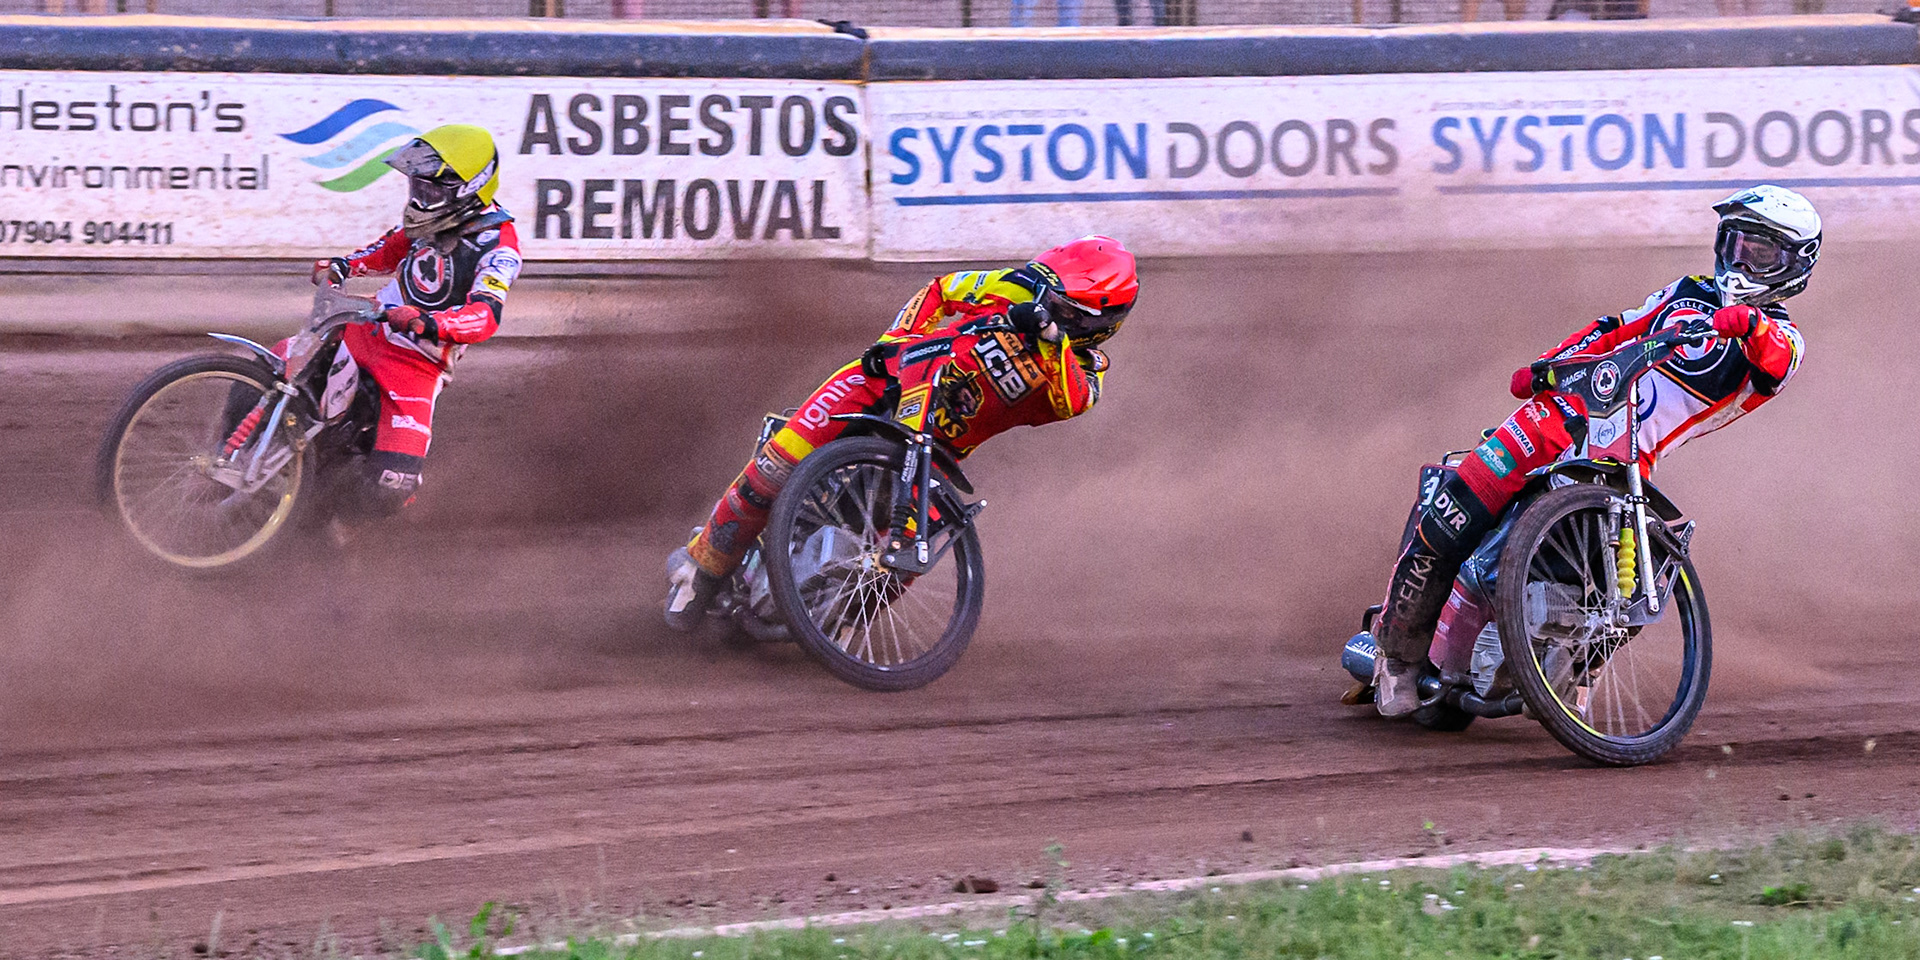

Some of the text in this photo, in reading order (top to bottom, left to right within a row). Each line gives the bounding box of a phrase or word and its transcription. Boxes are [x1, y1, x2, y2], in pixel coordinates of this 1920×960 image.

[0, 84, 246, 132] Heston's
[518, 93, 858, 157] ASBESTOS
[889, 117, 1399, 185] SYSTON DOORS
[1431, 108, 1920, 175] SYSTON DOORS
[534, 178, 841, 241] REMOVAL
[83, 221, 174, 244] 904411
[1672, 300, 1705, 312] BELLE
[974, 339, 1027, 399] JCB
[899, 403, 921, 419] JCB
[1552, 395, 1578, 417] CHP
[1508, 419, 1535, 456] PRONAR
[1434, 492, 1467, 531] DVR
